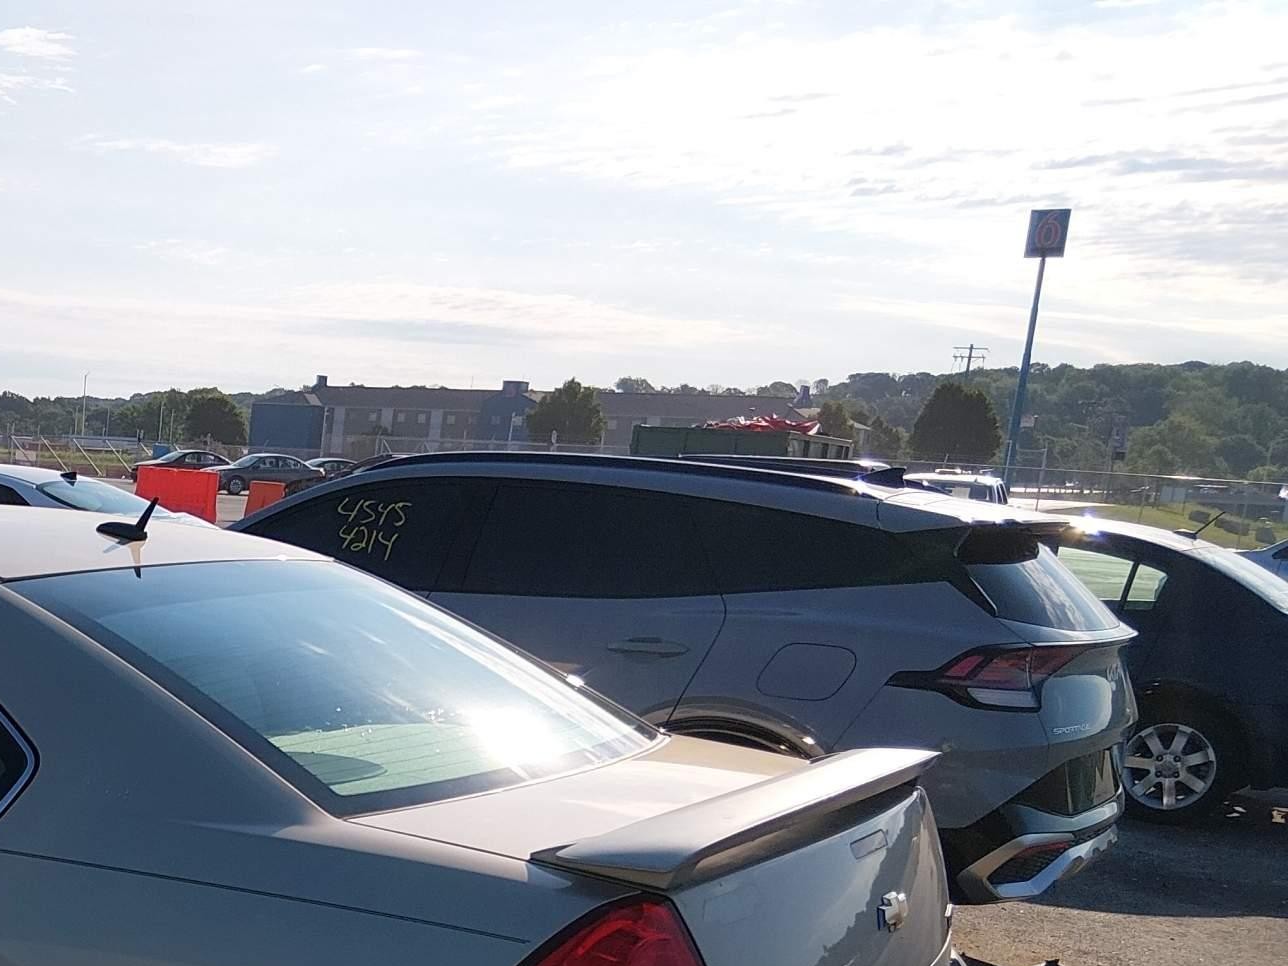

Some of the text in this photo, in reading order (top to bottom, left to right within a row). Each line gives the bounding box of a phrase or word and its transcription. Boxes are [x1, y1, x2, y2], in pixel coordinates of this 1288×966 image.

[1035, 210, 1061, 248] 6
[337, 497, 412, 527] 4545
[338, 525, 399, 561] 4214
[1052, 722, 1093, 735] SPORT
